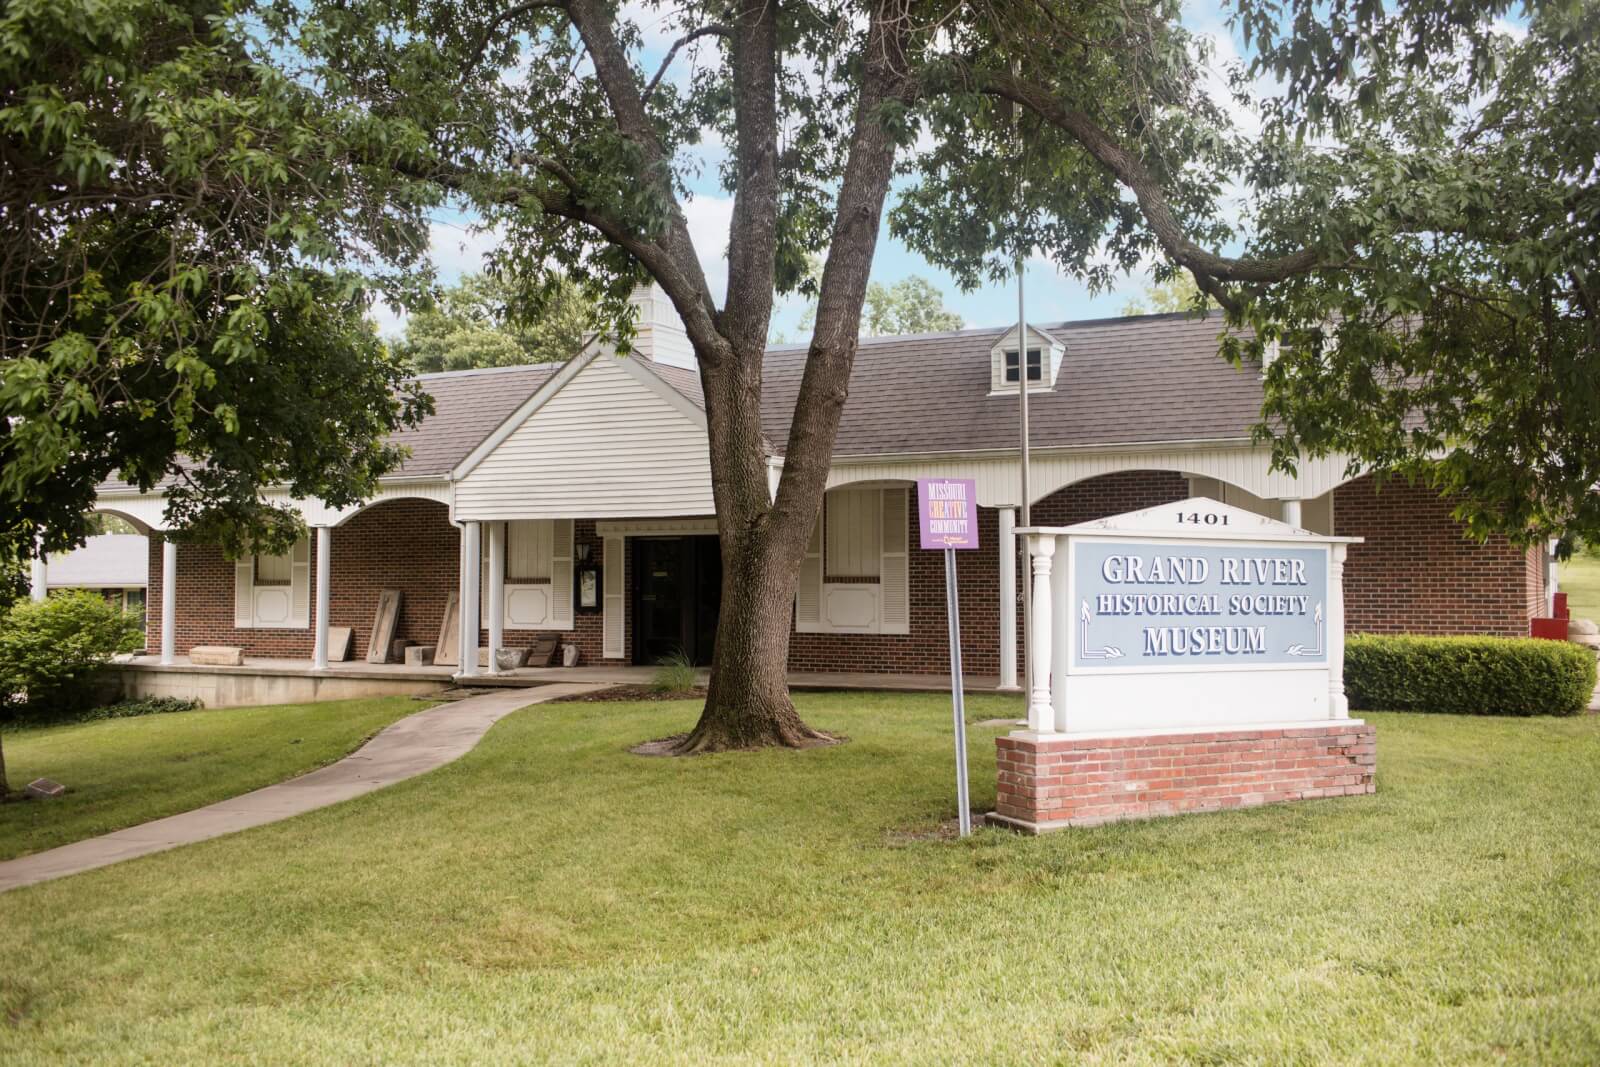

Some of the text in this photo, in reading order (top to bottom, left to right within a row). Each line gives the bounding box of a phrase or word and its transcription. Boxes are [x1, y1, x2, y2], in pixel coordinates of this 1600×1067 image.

[928, 483, 966, 500] MISSOURI
[929, 501, 967, 518] CREATIVE
[930, 519, 968, 534] COMMUNITY
[1176, 511, 1228, 526] 1401
[1102, 555, 1307, 585] GRAND RIVER
[1096, 594, 1310, 616] HISTORICAL SOCIETY
[1143, 626, 1267, 656] MUSEUM
